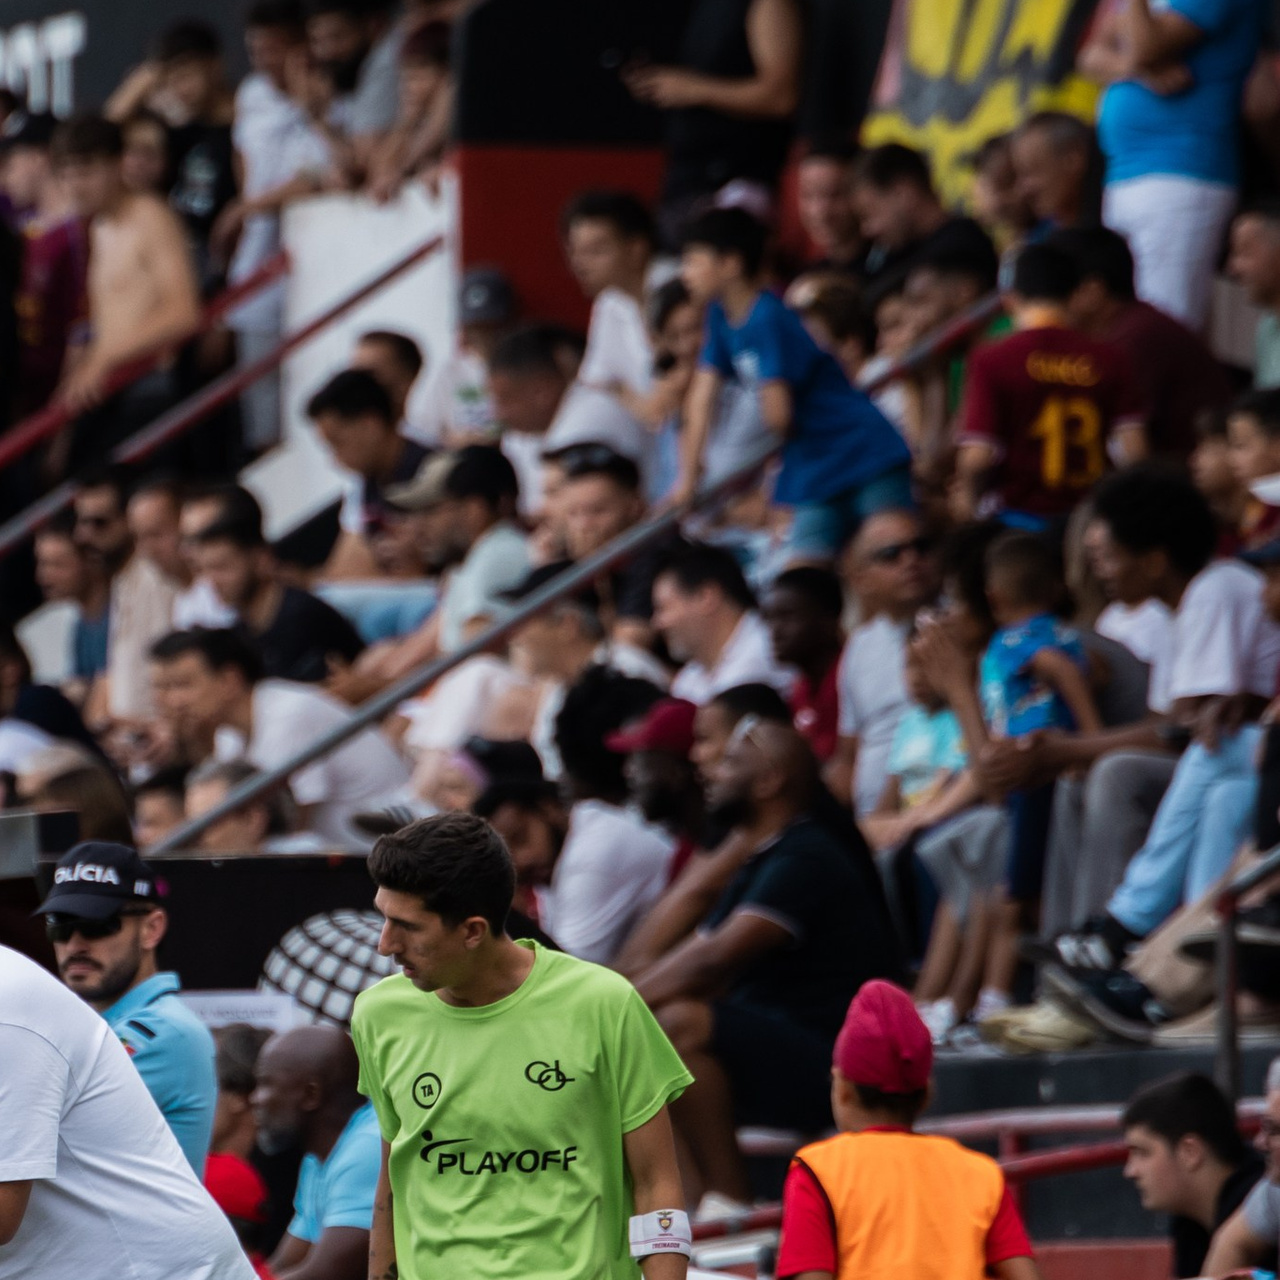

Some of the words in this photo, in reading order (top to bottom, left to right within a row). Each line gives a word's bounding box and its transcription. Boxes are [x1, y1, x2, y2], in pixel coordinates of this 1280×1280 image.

[54, 861, 120, 886] OLÍCIA
[421, 1084, 434, 1098] TA
[437, 1146, 577, 1175] PLAYOFF
